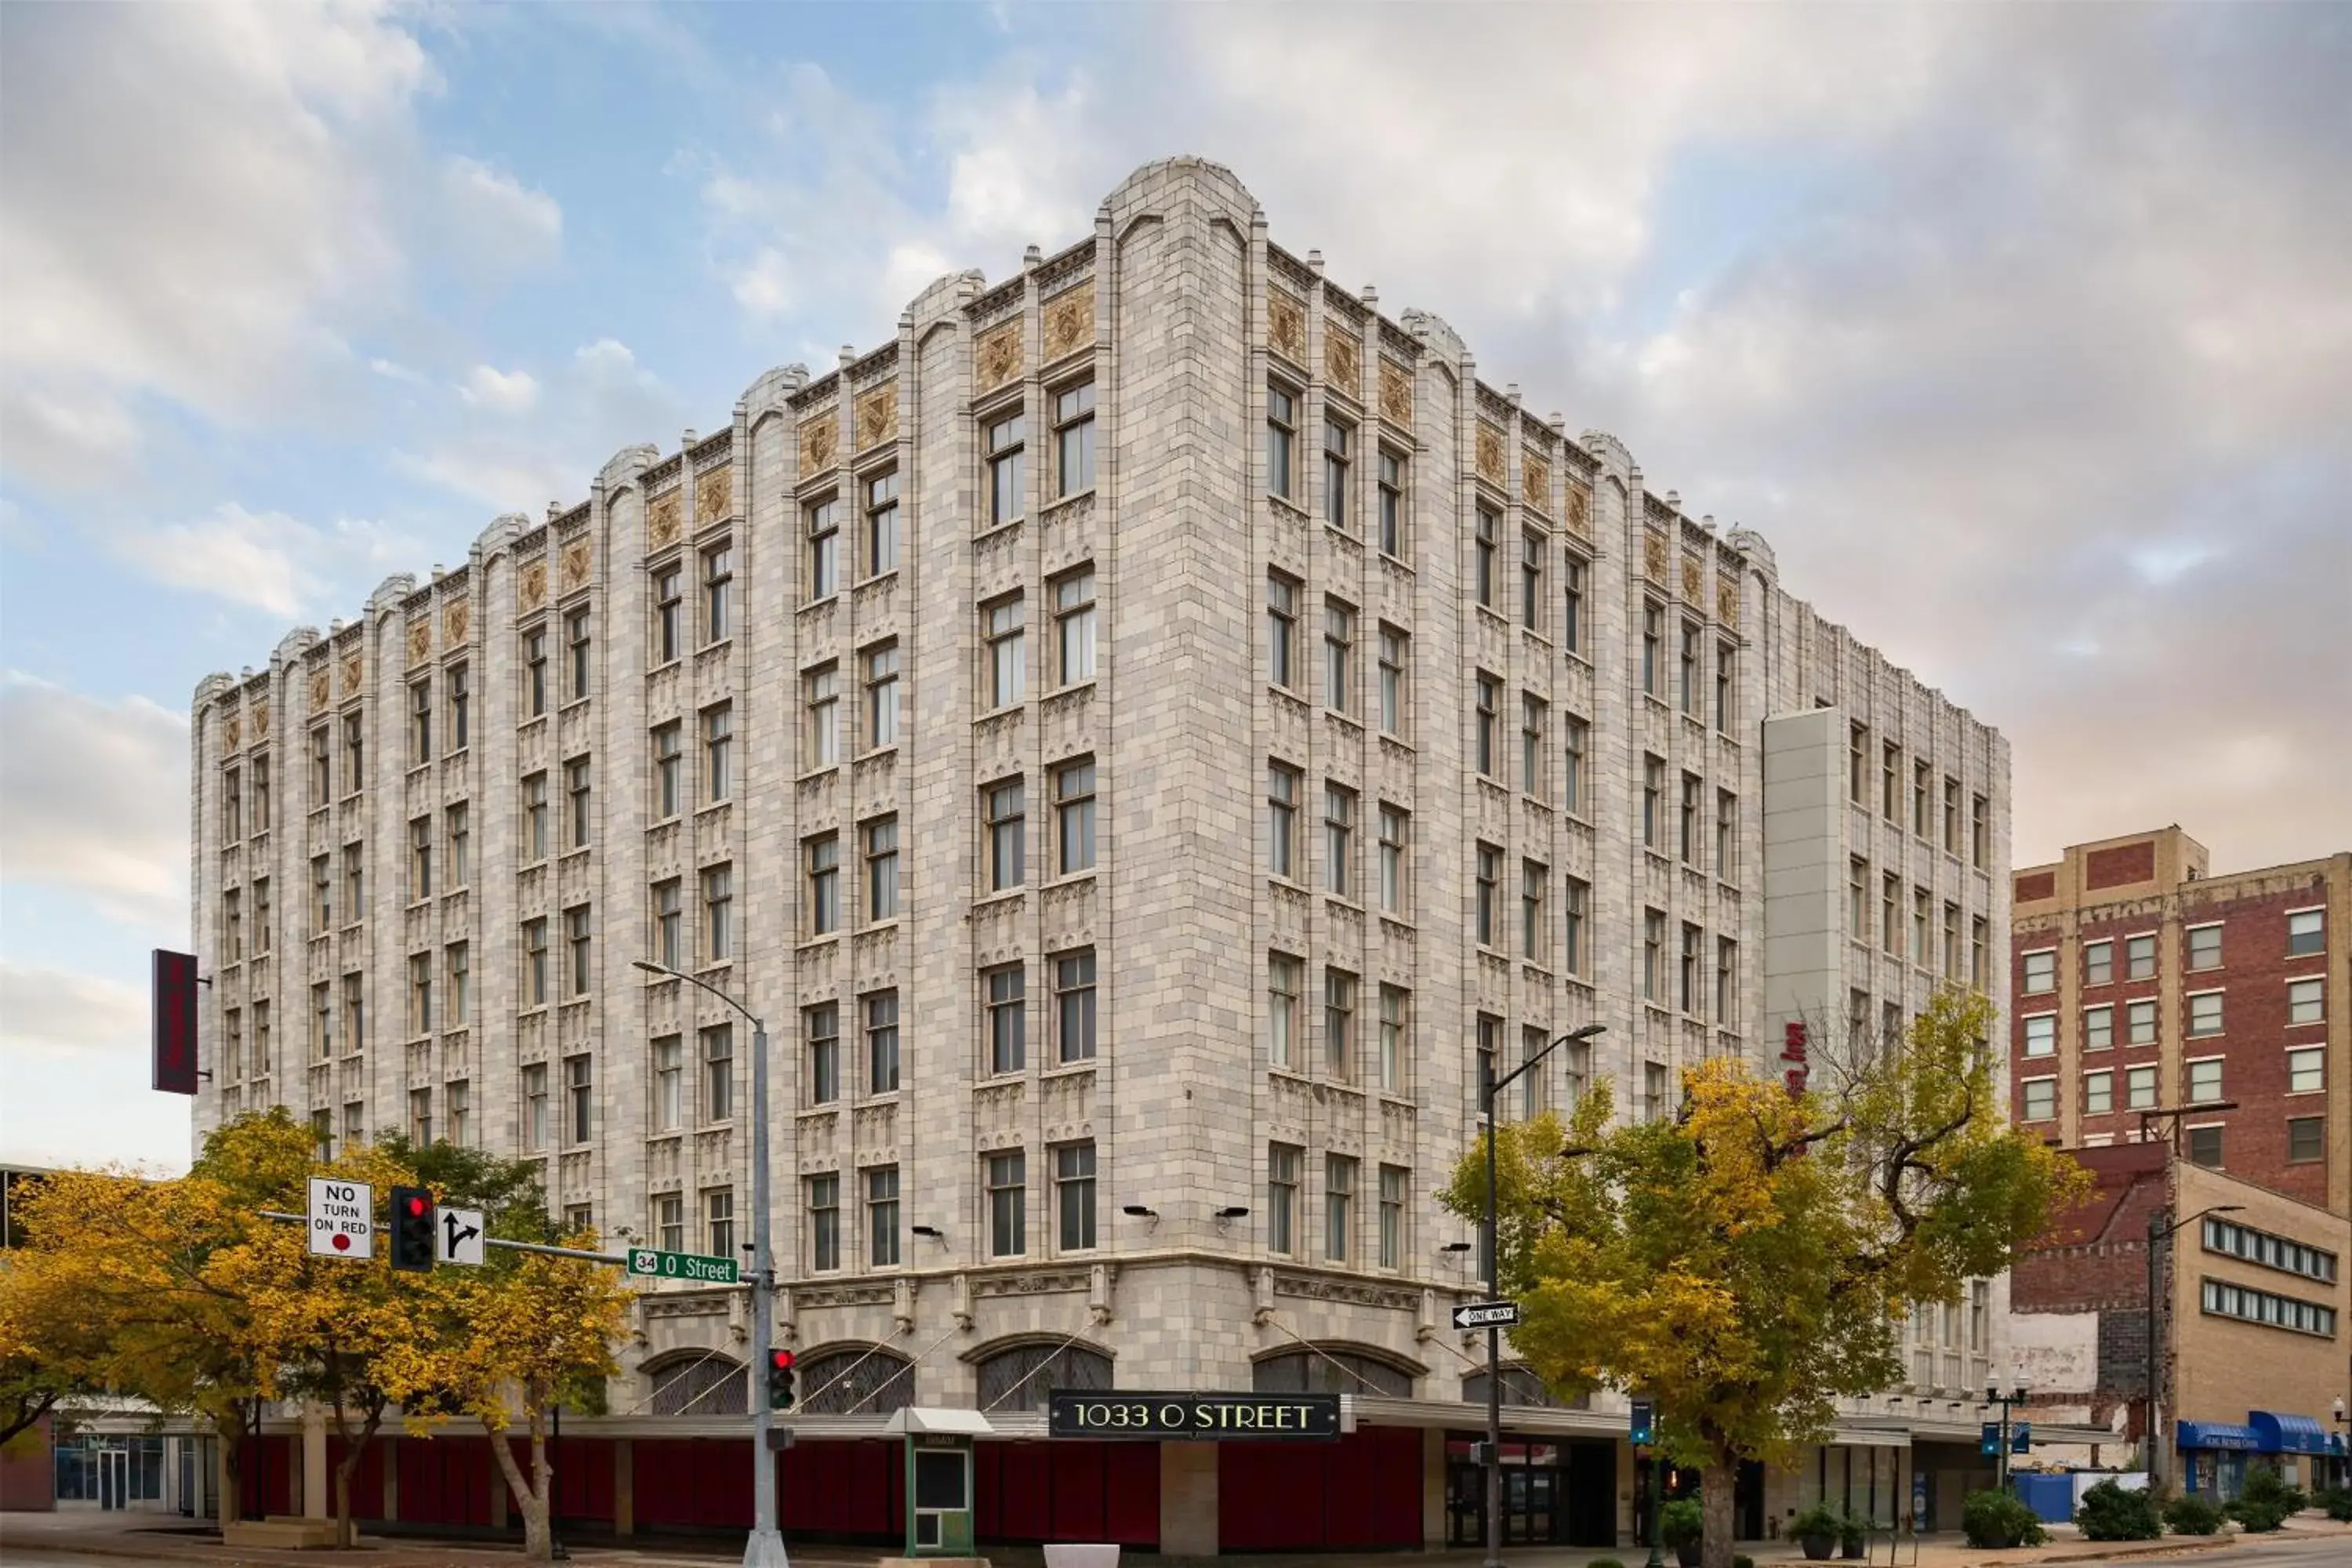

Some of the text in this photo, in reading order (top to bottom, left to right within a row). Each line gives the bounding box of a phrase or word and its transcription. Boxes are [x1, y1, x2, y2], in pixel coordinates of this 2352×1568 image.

[326, 1185, 355, 1202] NO
[323, 1203, 360, 1218] TURN
[314, 1218, 367, 1235] ON RED
[637, 1256, 655, 1269] 34
[686, 1258, 731, 1280] Street
[1490, 1308, 1511, 1319] WAY
[1075, 1404, 1315, 1428] 1033 O STREET
